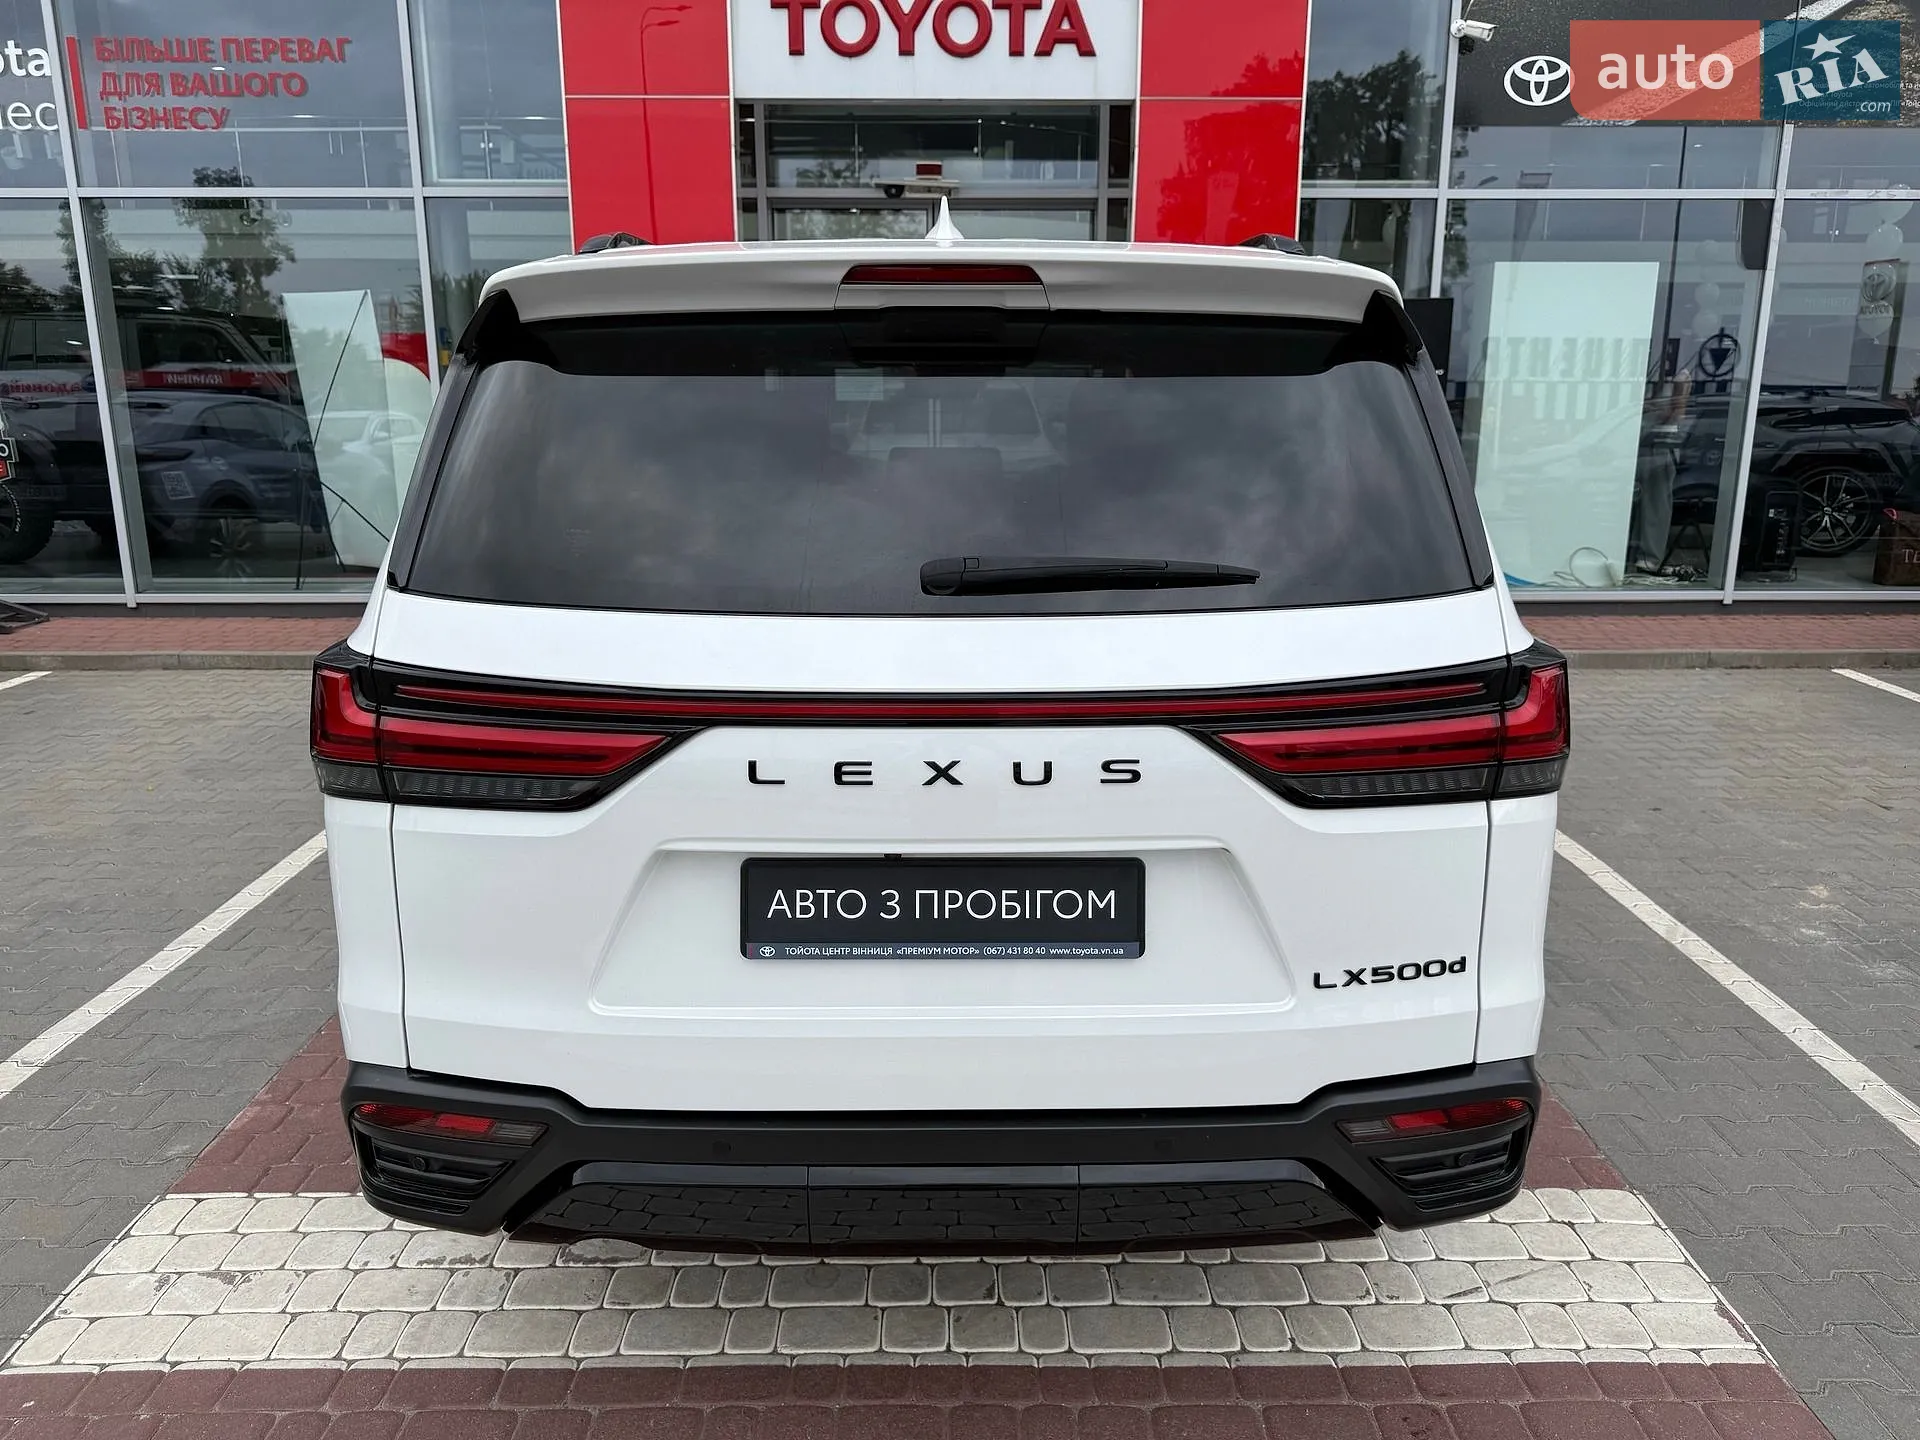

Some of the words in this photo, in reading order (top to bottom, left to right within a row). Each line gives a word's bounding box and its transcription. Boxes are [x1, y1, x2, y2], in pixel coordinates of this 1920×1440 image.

[771, 0, 1096, 58] TOYOTA
[0, 40, 52, 76] ta
[93, 37, 216, 62] БІЛЬШЕ
[221, 37, 351, 62] ПЕРЕВАГ
[100, 71, 163, 101] ДЛЯ
[169, 72, 308, 98] ВАШОГО
[0, 102, 59, 131] ес
[103, 106, 230, 131] БІЗНЕСУ
[747, 758, 1142, 786] LEXUS
[766, 889, 868, 920] АВТО
[879, 889, 901, 920] З
[914, 889, 1116, 920] ПРОБІГОМ
[785, 945, 821, 956] ТОЙОТА
[822, 947, 850, 957] ЦЕНТР
[852, 947, 893, 957] ВІННИЦЯ
[896, 947, 941, 956] «ПРЕМІУМ
[943, 947, 980, 956] МОТОР»
[983, 946, 1006, 957] (067)
[1007, 947, 1021, 956] 431
[1023, 947, 1034, 956] 80
[1035, 947, 1047, 956] 40
[1049, 946, 1124, 957] www.toyota.vn.ua
[1313, 956, 1467, 989] LX500d
